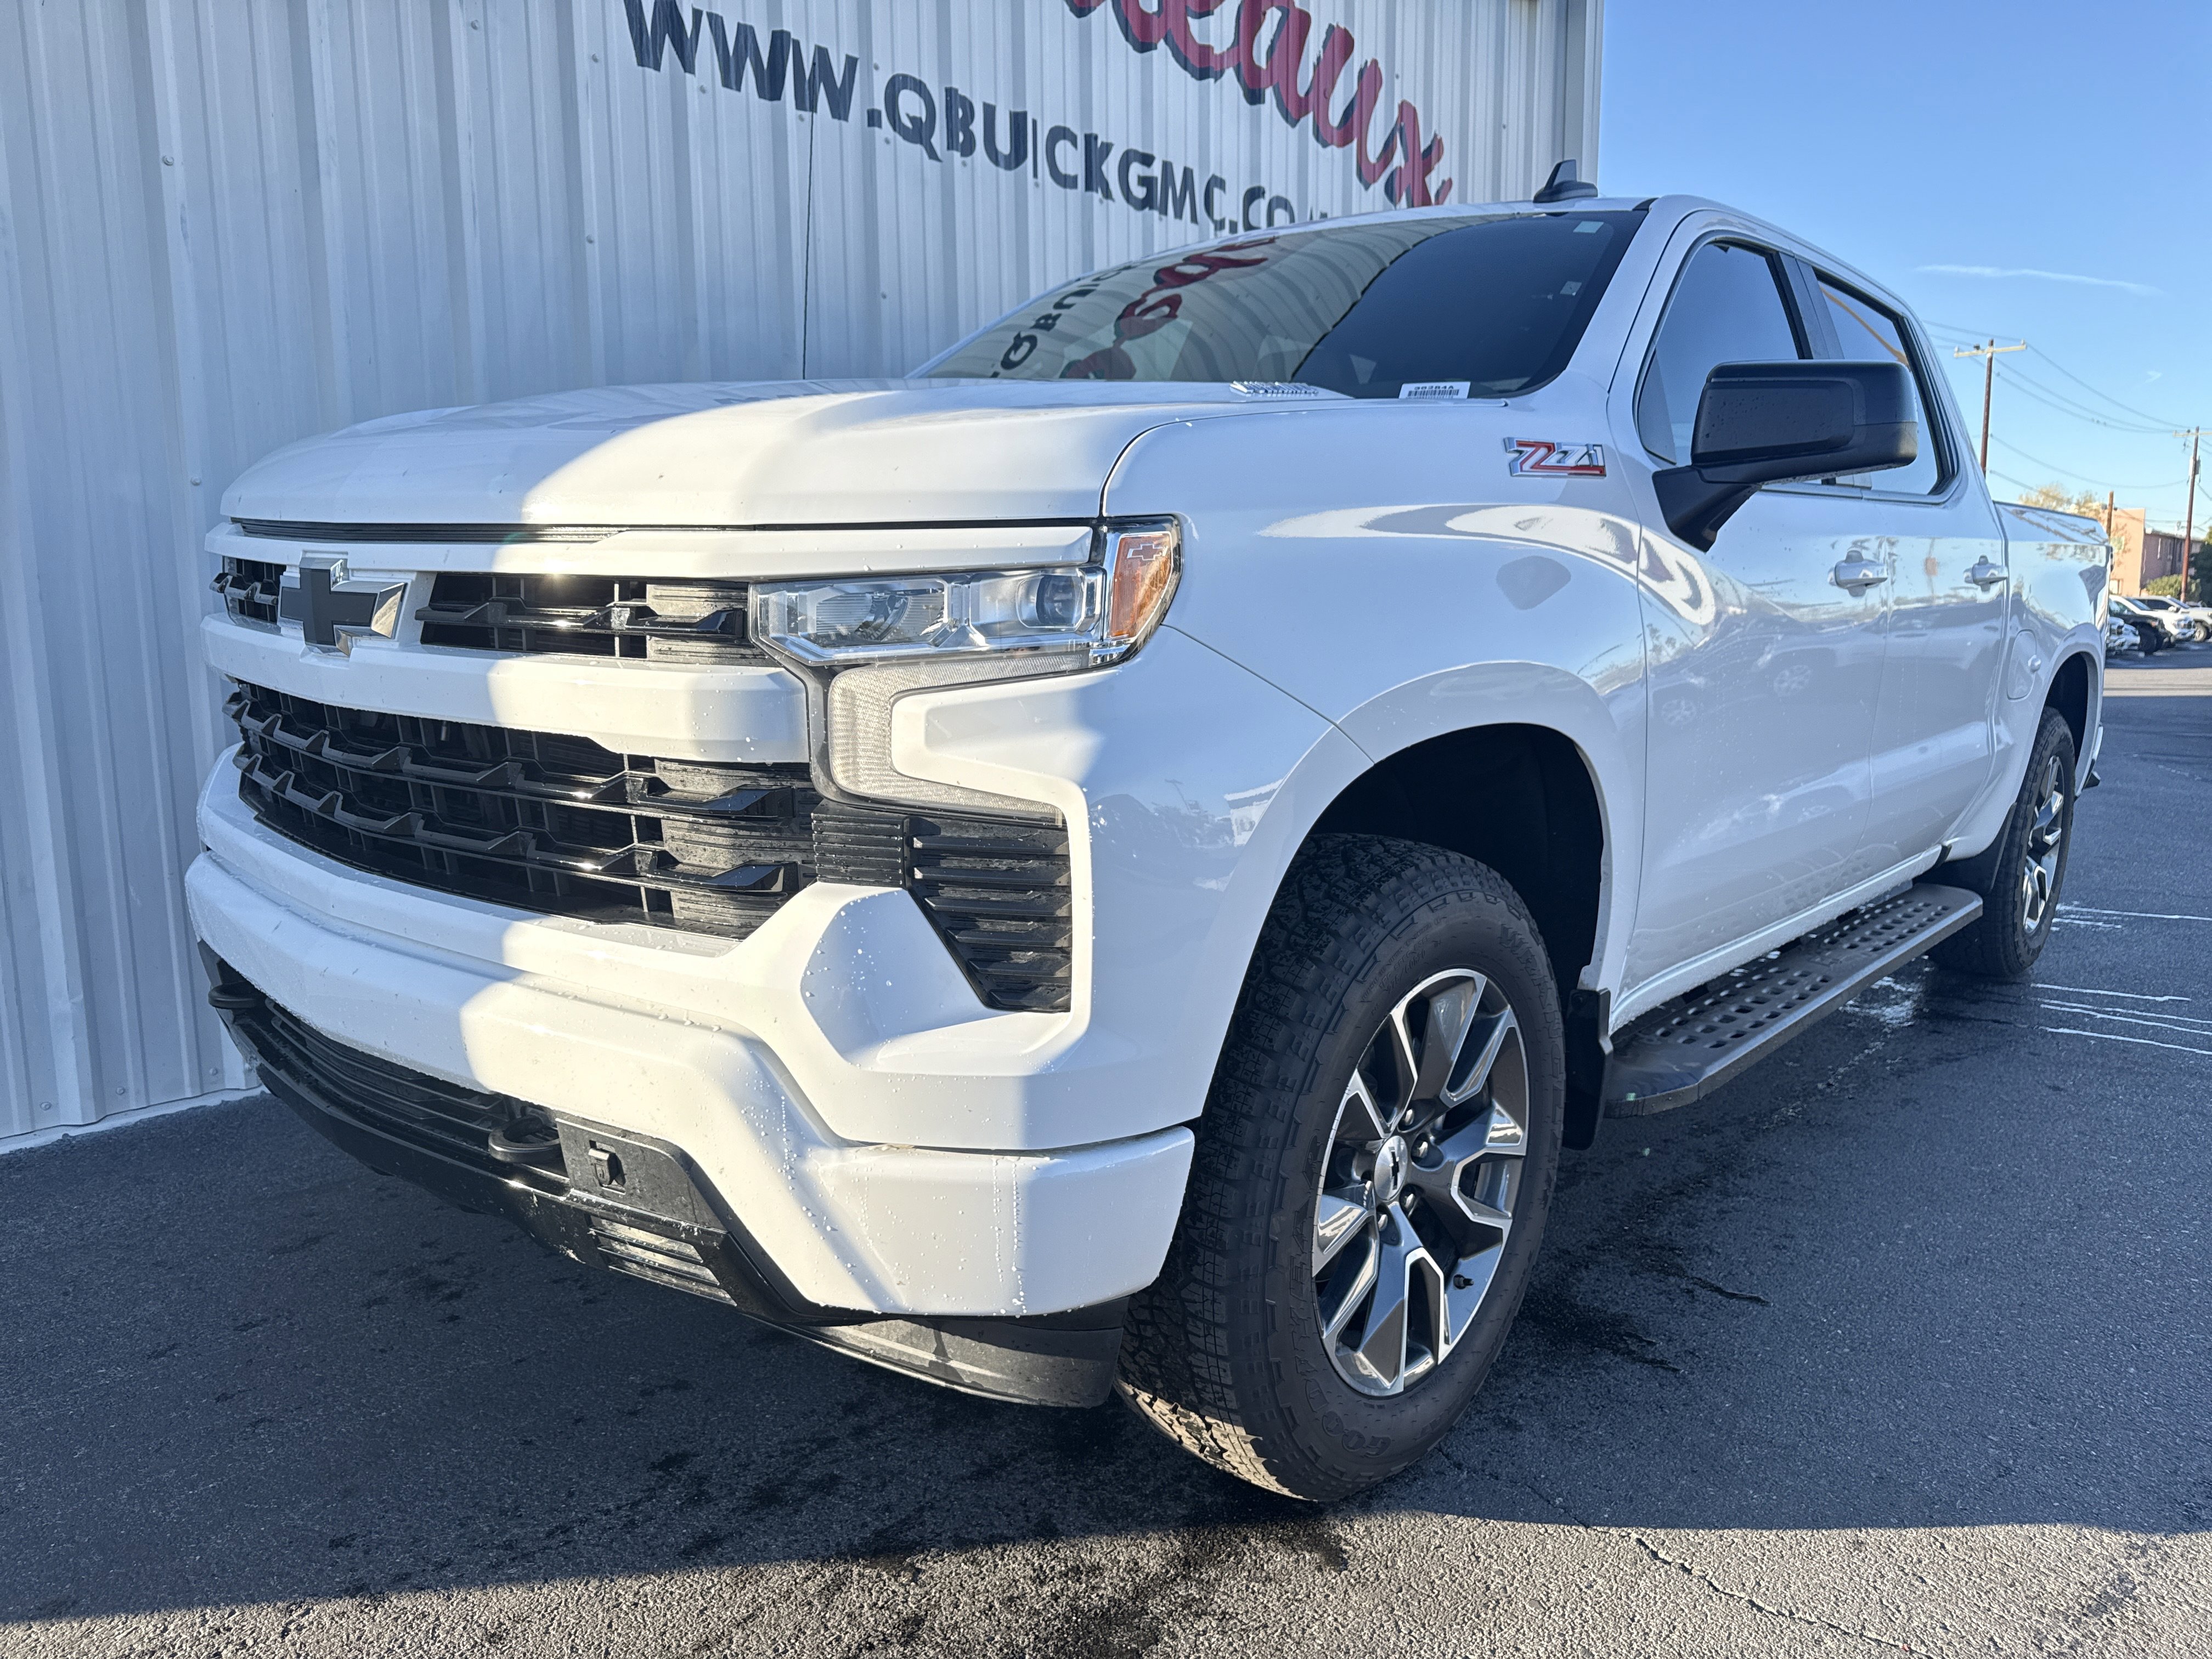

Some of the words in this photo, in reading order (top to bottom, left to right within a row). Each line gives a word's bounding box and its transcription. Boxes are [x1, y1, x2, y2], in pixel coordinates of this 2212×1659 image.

[624, 0, 1328, 234] WWW.QBUICKGMC.CO
[1503, 437, 1607, 477] Z71
[1290, 1133, 1392, 1457] GOODYEAR
